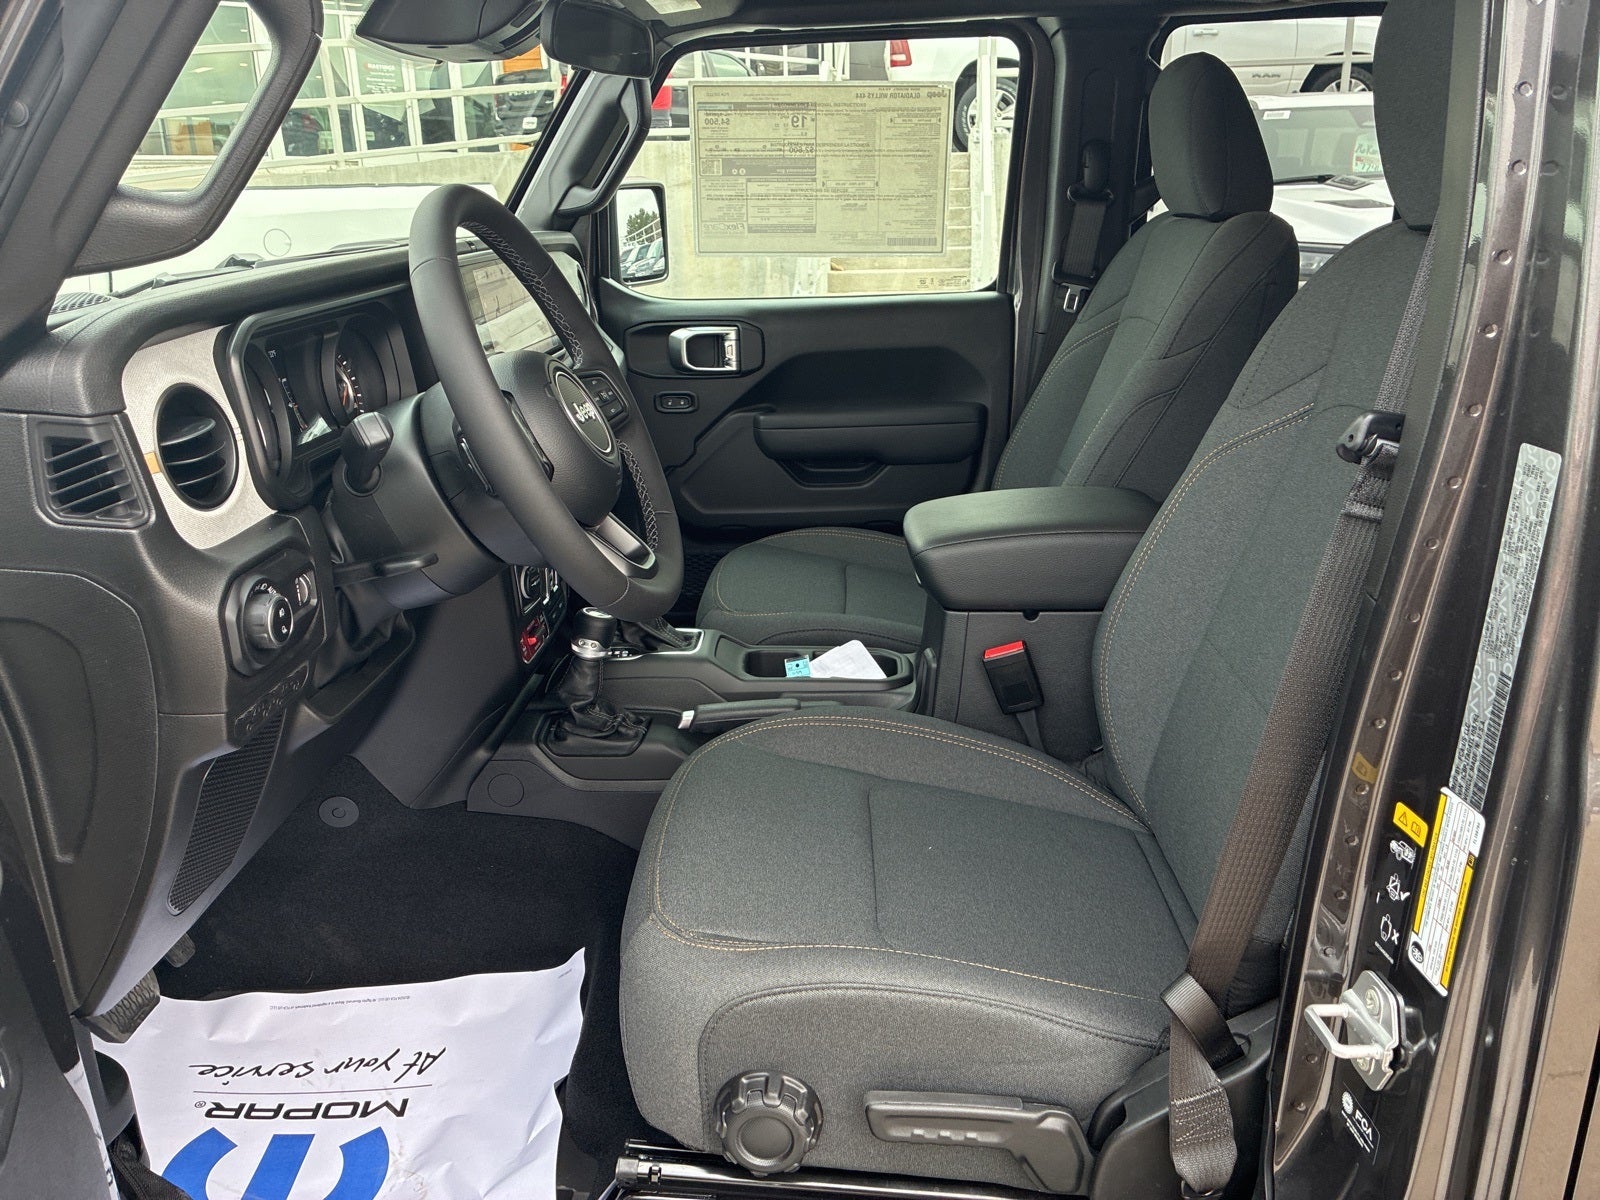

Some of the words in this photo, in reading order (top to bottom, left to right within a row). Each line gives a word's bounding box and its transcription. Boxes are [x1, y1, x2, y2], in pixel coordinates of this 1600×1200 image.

[573, 402, 596, 422] Jeep
[189, 1061, 314, 1086] service
[324, 1048, 400, 1075] your
[393, 1047, 446, 1083] At
[204, 1098, 409, 1120] MOPAR
